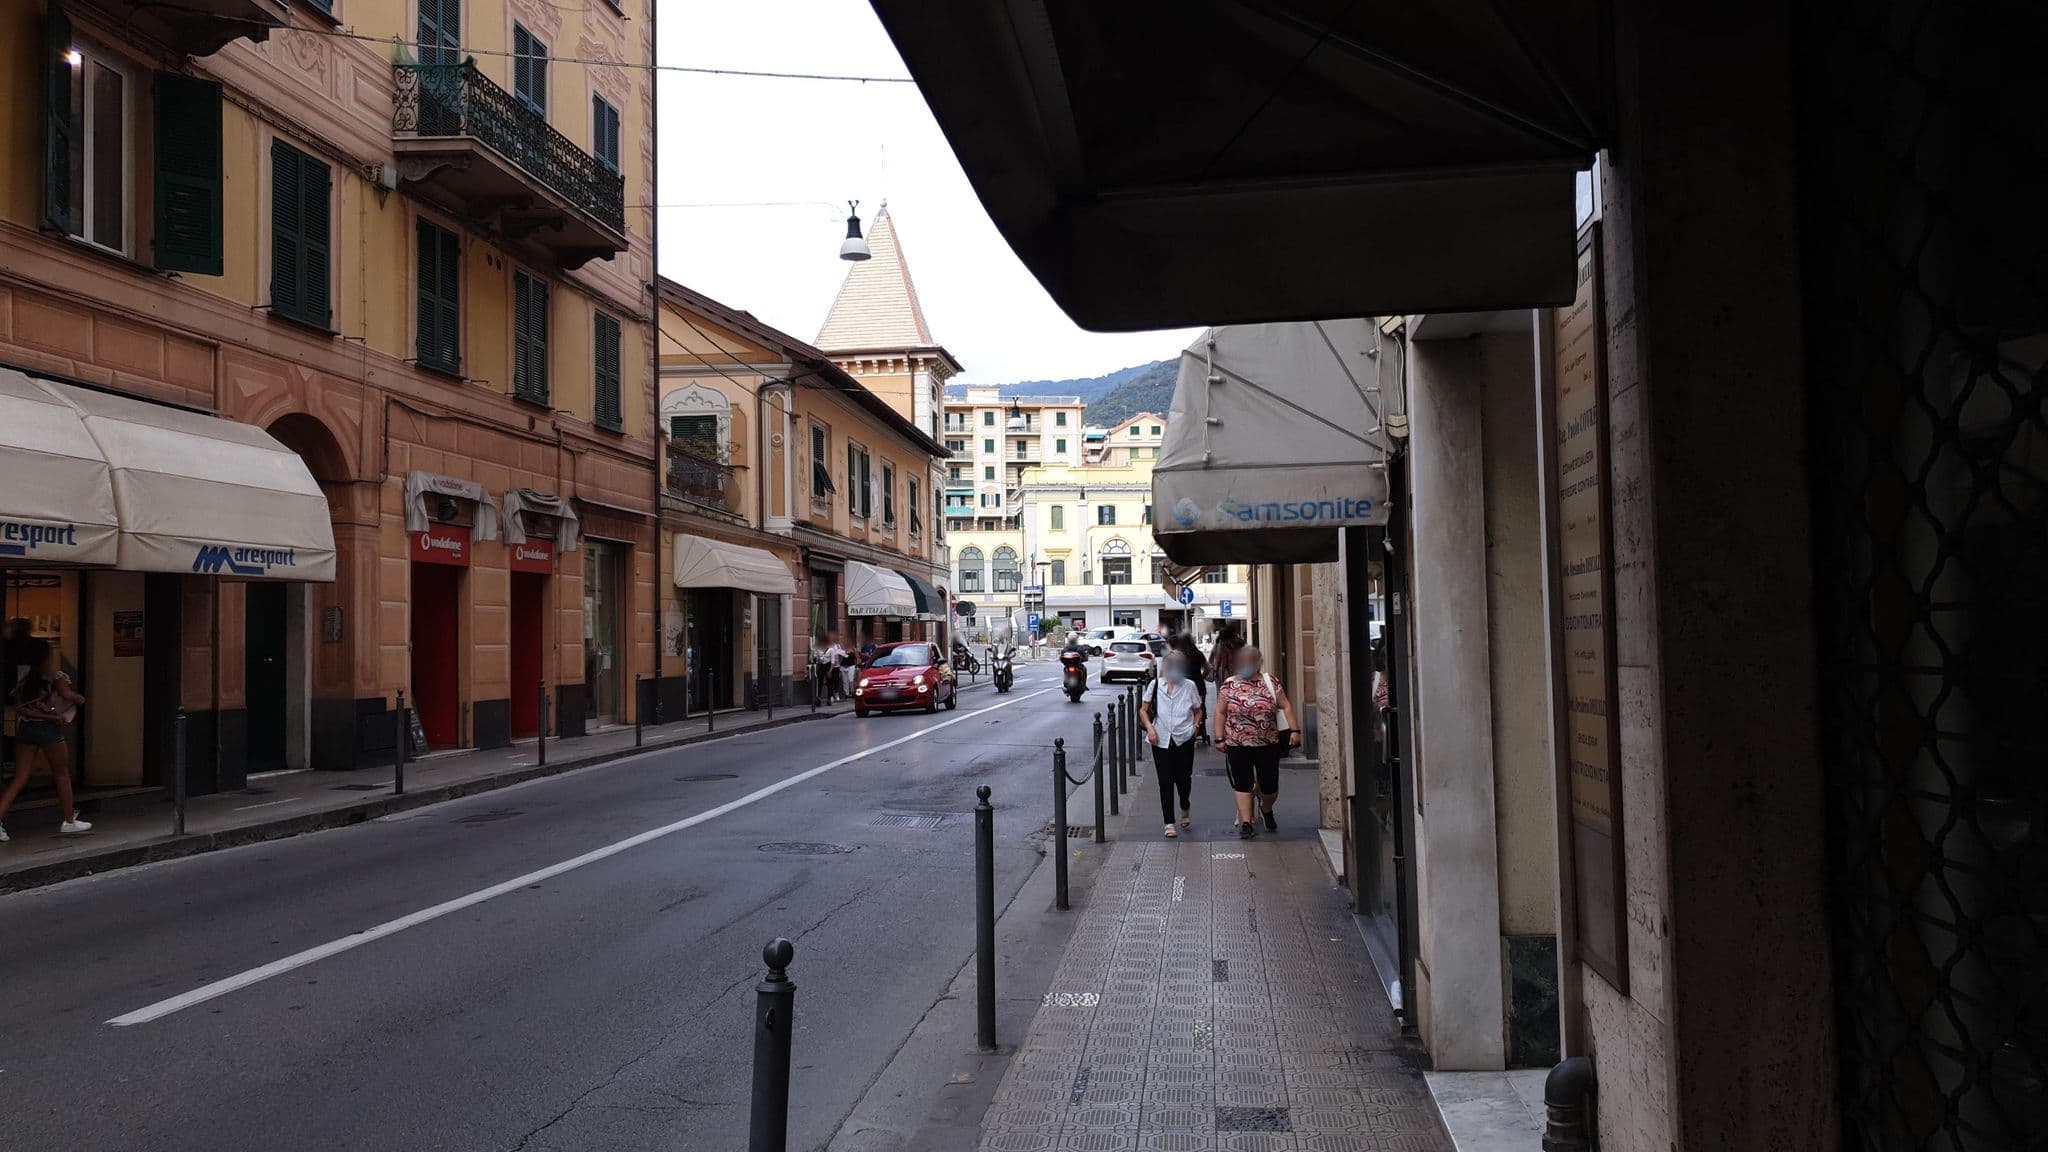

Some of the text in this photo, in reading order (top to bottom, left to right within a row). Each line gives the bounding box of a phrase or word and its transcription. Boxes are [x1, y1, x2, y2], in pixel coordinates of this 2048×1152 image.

[1216, 496, 1372, 522] Samsonite
[431, 536, 462, 551] vodafone
[523, 549, 549, 561] vodafone
